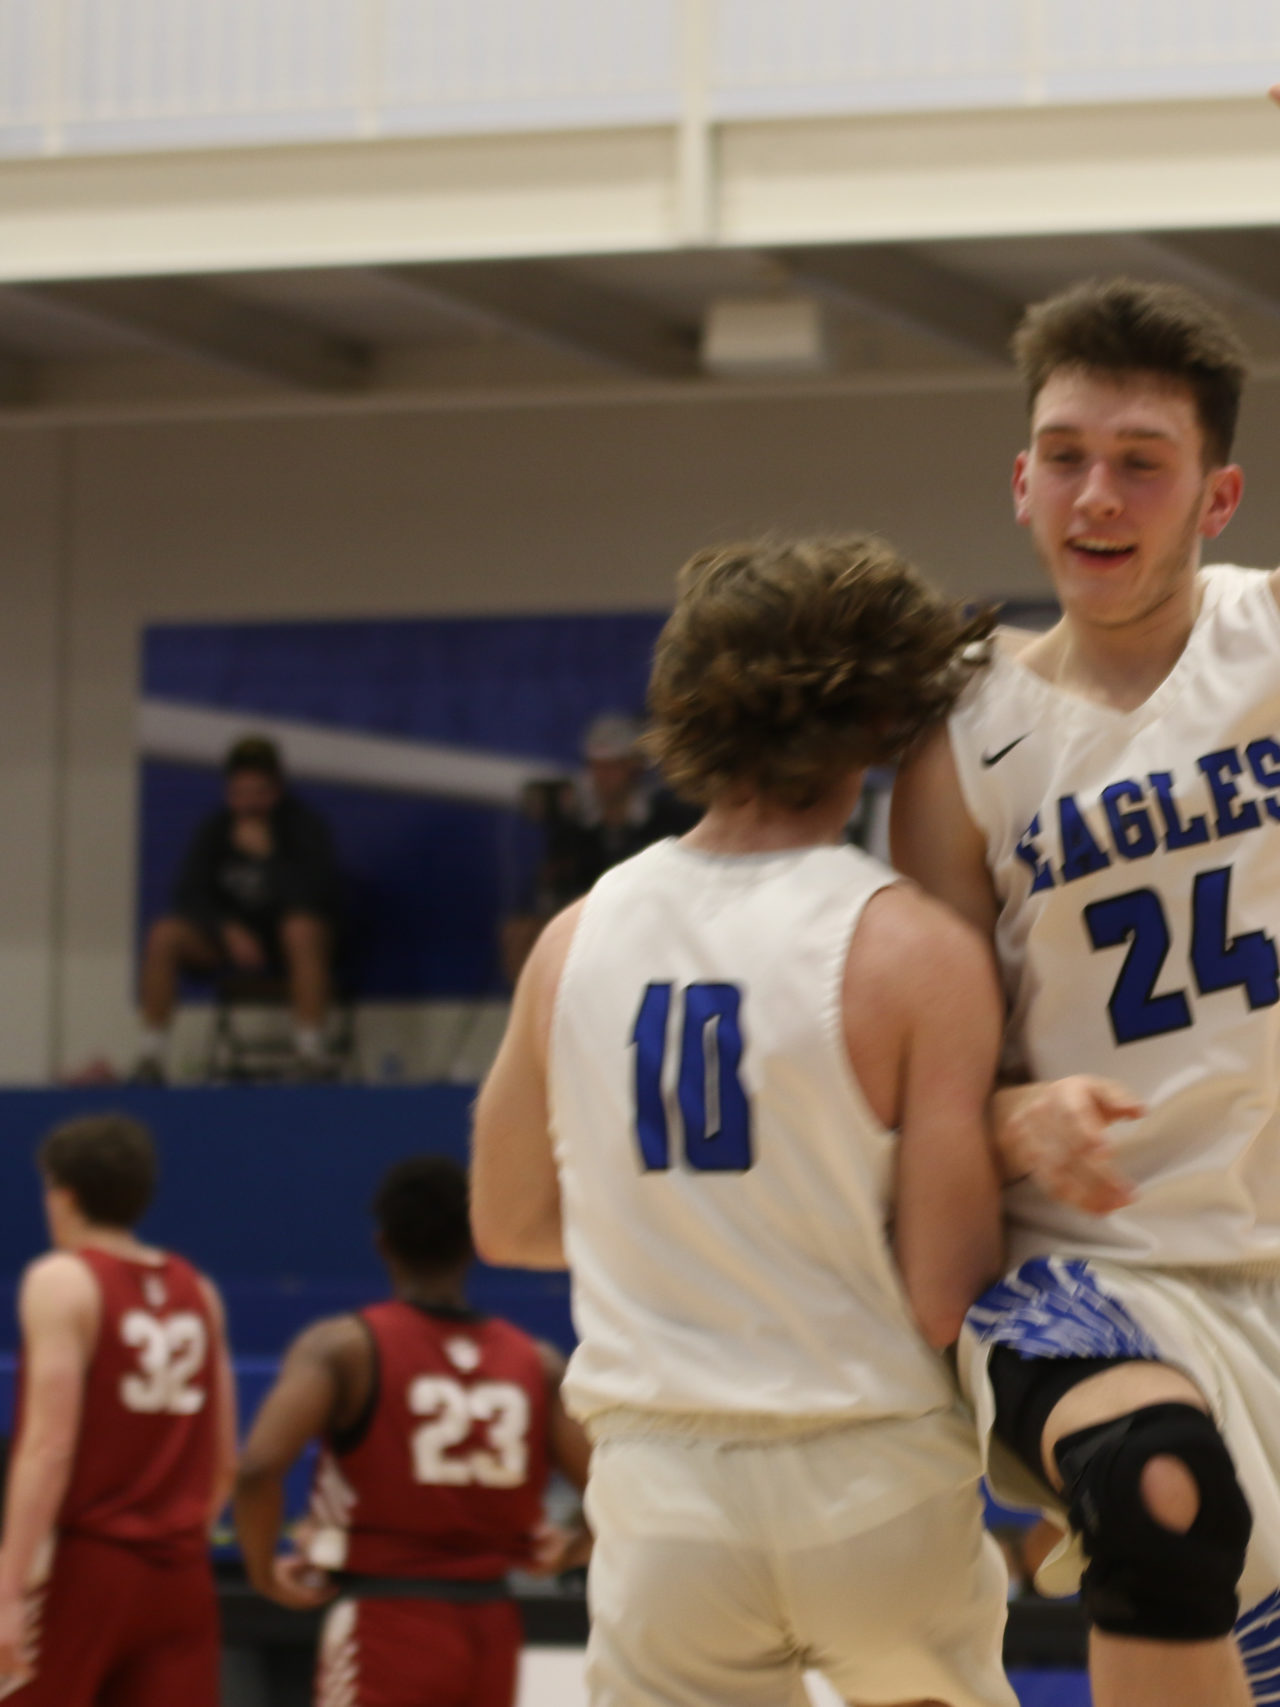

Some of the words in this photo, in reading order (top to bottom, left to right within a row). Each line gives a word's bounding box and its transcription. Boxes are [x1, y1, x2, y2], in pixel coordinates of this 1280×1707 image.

[1083, 865, 1280, 1046] 24
[629, 981, 755, 1172] 10
[121, 1312, 205, 1413] 32
[409, 1375, 529, 1485] 23
